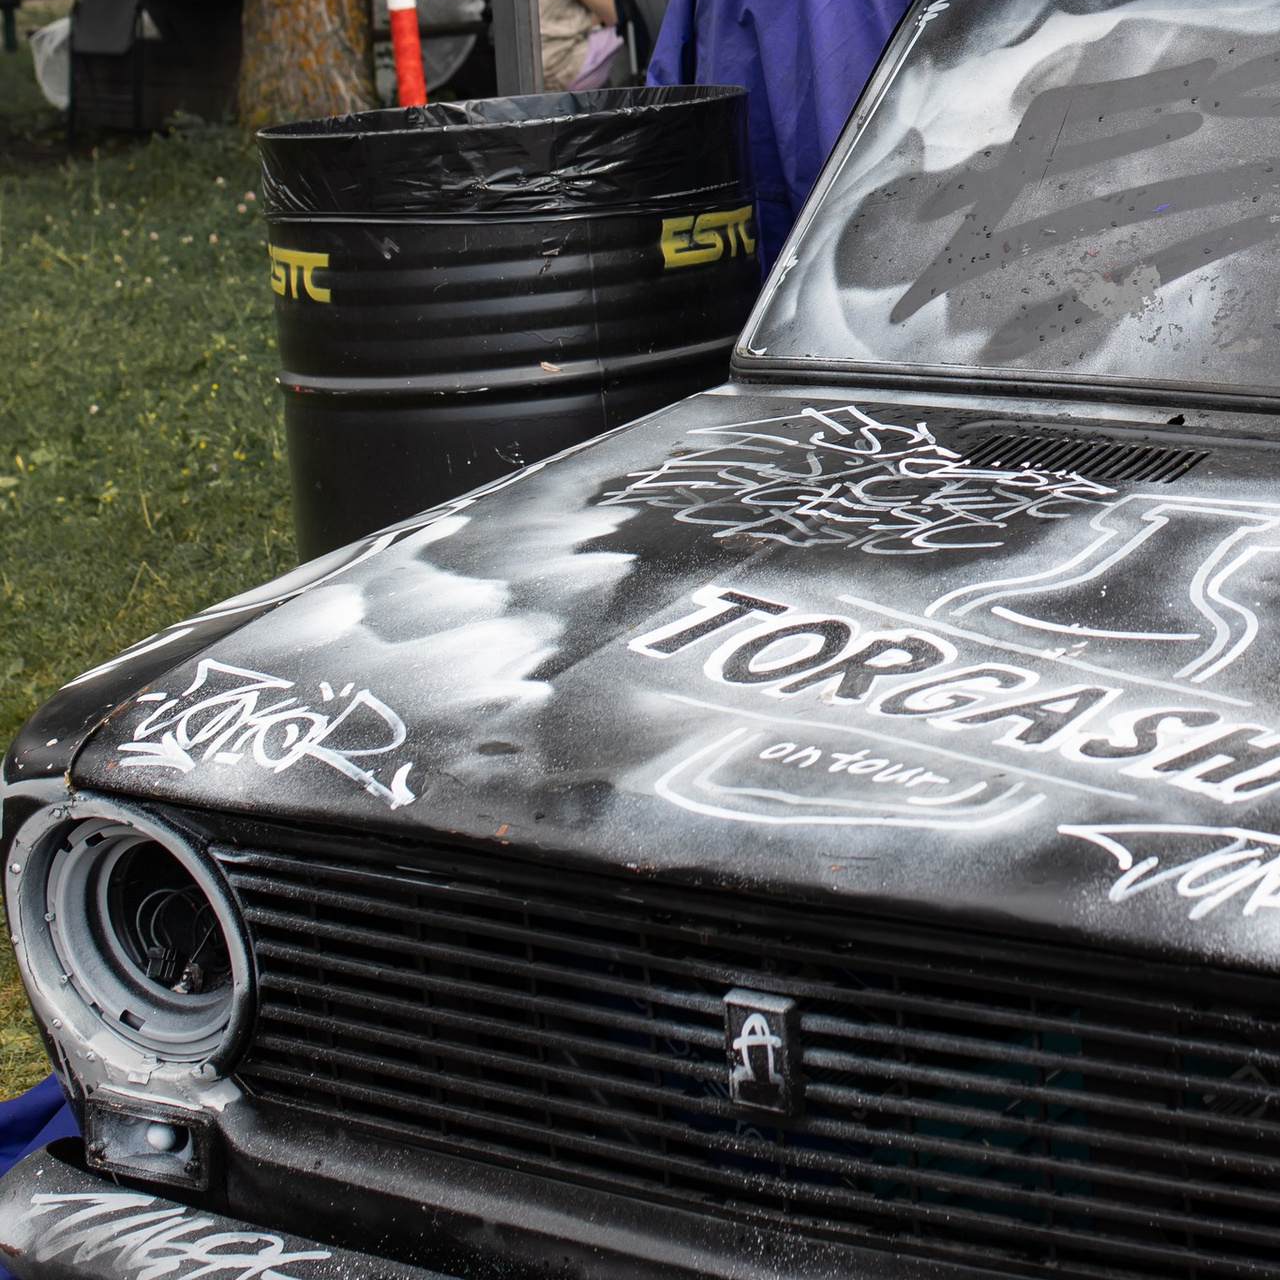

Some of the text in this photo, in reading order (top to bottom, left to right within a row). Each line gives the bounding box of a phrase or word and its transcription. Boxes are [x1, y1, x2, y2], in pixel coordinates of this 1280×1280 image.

[662, 206, 757, 269] ESTC
[268, 242, 331, 303] STC
[759, 741, 951, 788] on tour
